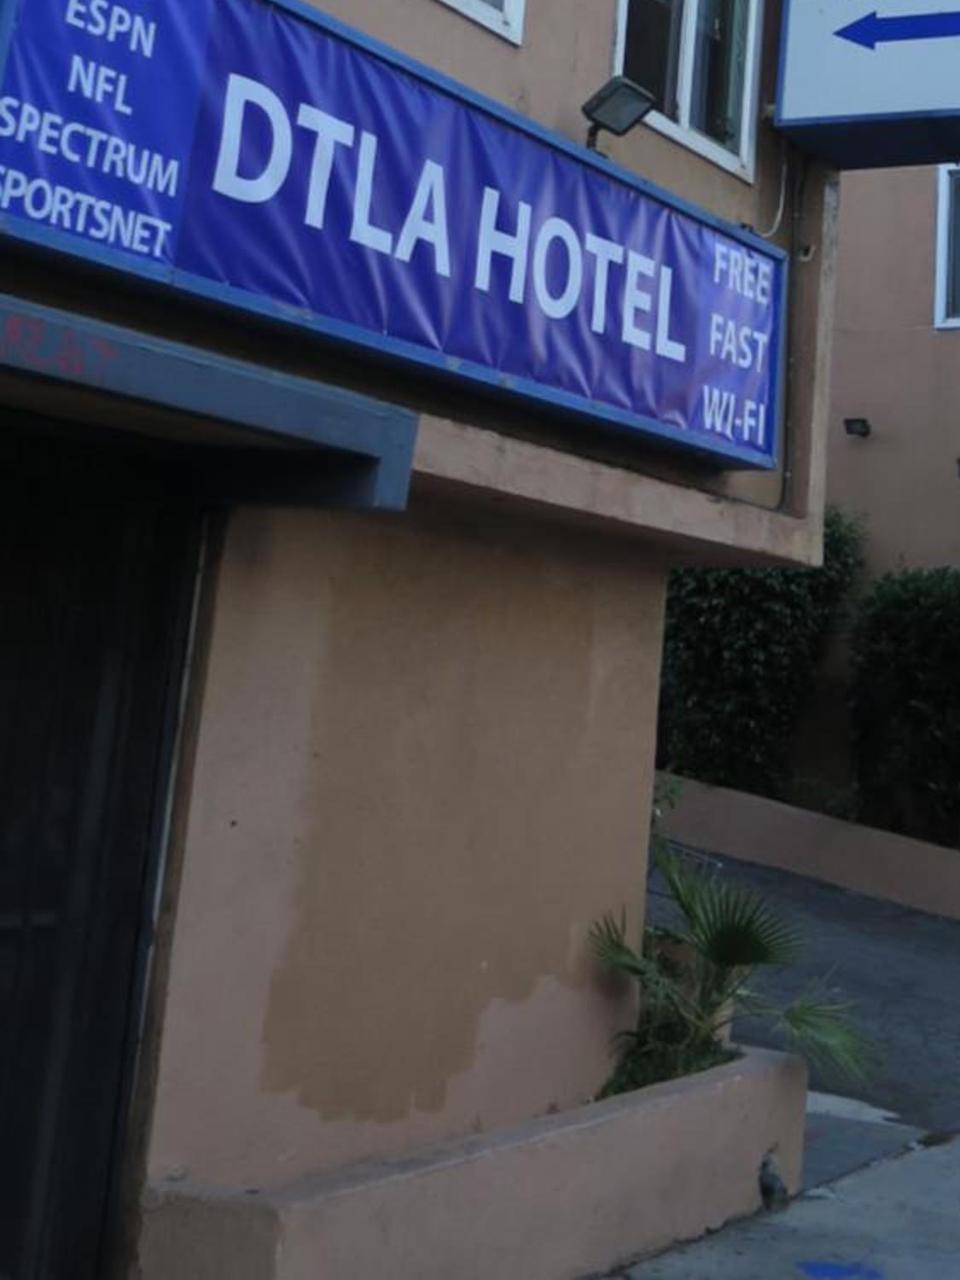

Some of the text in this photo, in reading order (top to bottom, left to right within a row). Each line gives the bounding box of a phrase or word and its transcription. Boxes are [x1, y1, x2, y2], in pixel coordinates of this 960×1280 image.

[67, 54, 132, 115] NFL
[0, 95, 180, 197] SPECTRUM
[211, 72, 687, 363] DTLA HOTEL
[713, 241, 771, 305] FREE
[709, 312, 768, 373] FAST
[703, 383, 767, 446] WI-FI
